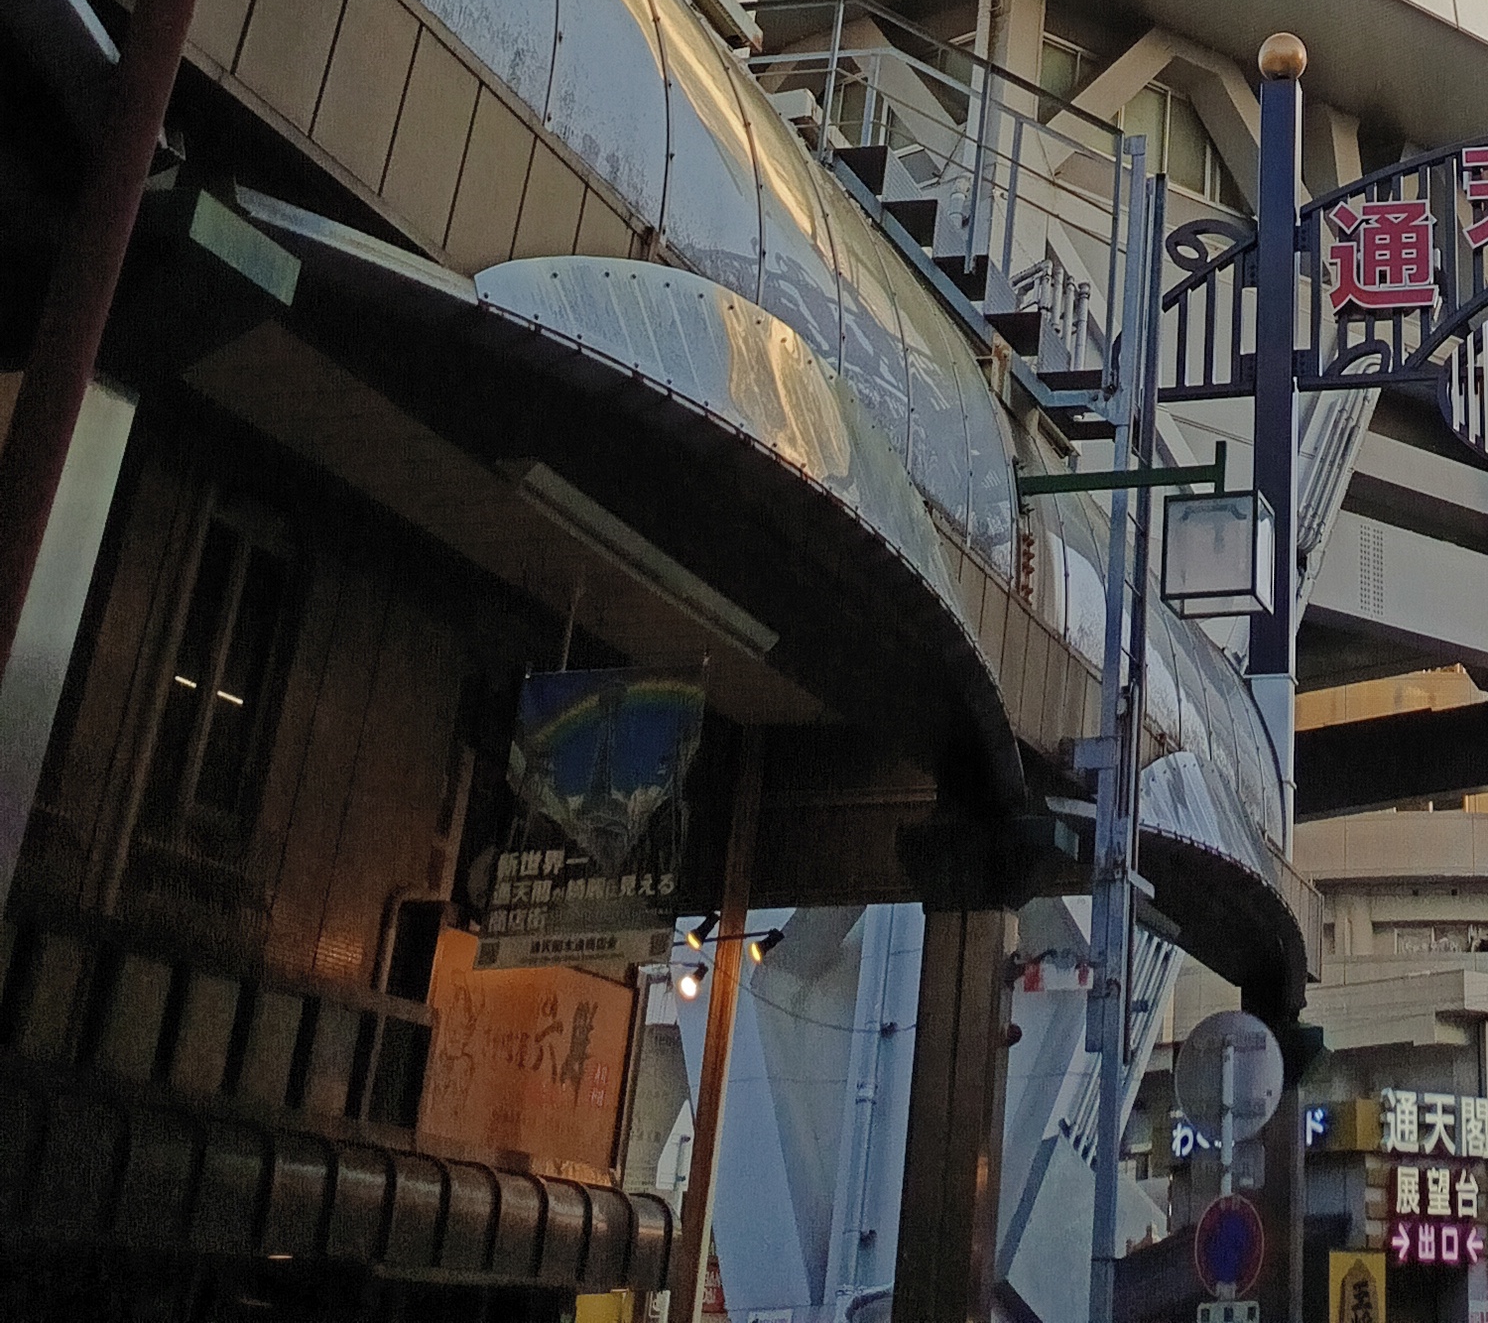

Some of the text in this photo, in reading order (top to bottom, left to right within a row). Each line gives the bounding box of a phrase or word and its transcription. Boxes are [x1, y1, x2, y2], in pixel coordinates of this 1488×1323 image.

[1396, 1166, 1479, 1218] 展望台
[1418, 1223, 1459, 1261] 出口
